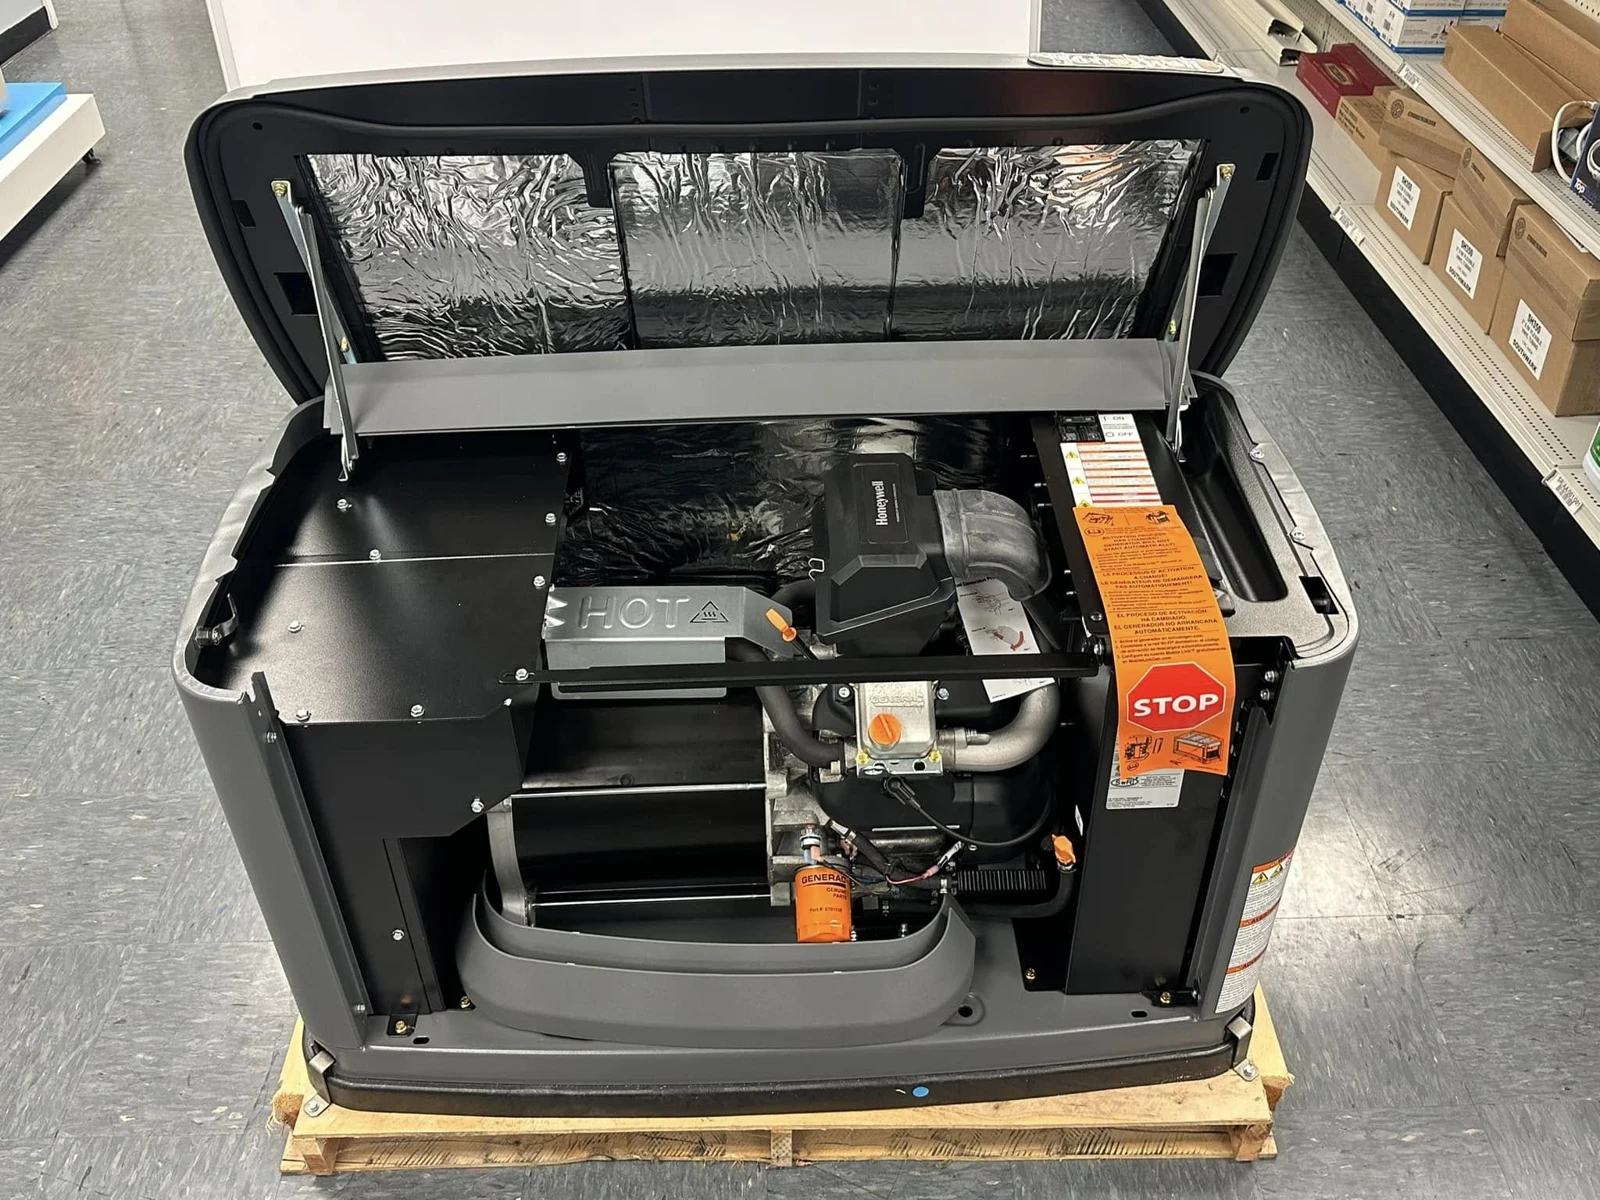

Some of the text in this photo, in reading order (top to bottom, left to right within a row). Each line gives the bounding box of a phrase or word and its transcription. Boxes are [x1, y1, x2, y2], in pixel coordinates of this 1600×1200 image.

[1512, 338, 1538, 373] SOUTHWARK
[871, 481, 888, 525] Honeywell
[578, 596, 690, 629] HOT
[1124, 622, 1165, 630] GENERADOR
[1133, 693, 1219, 717] STOP
[801, 874, 847, 884] GENERAC
